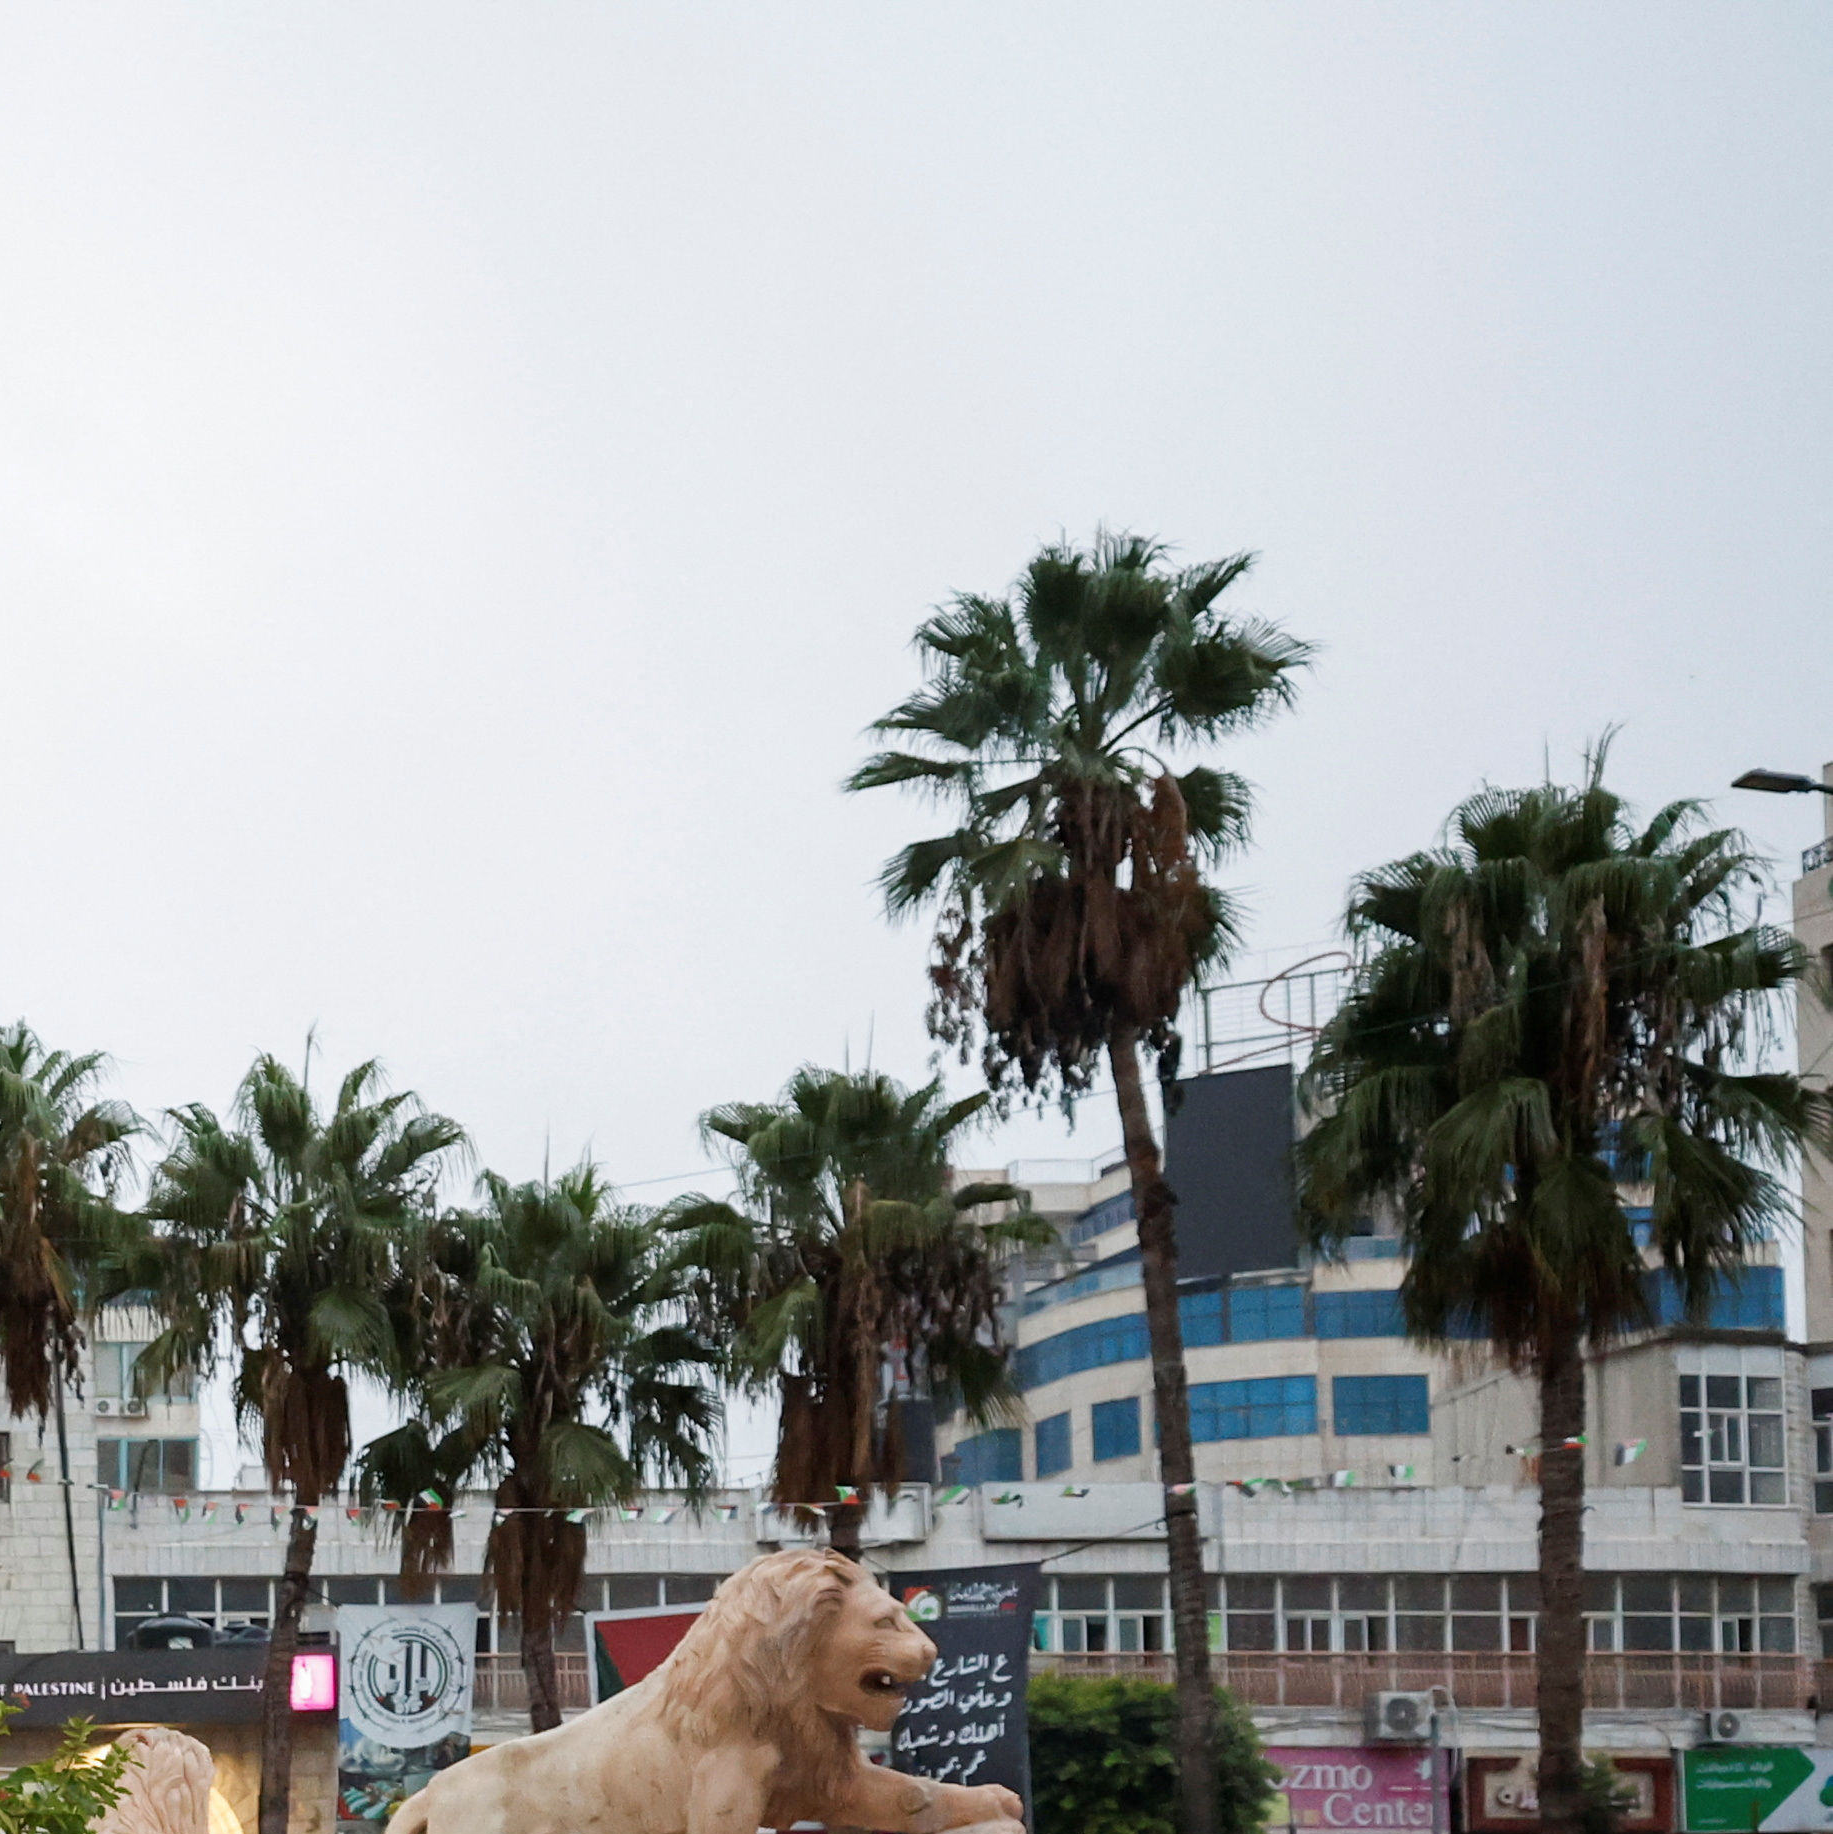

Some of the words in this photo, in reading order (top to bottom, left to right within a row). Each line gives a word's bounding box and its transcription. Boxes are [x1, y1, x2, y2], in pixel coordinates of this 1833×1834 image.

[927, 1653, 990, 1688] الشارع
[13, 1681, 96, 1697] PALESTINE
[111, 1676, 208, 1698] فلسطين
[212, 1674, 265, 1694] بنك
